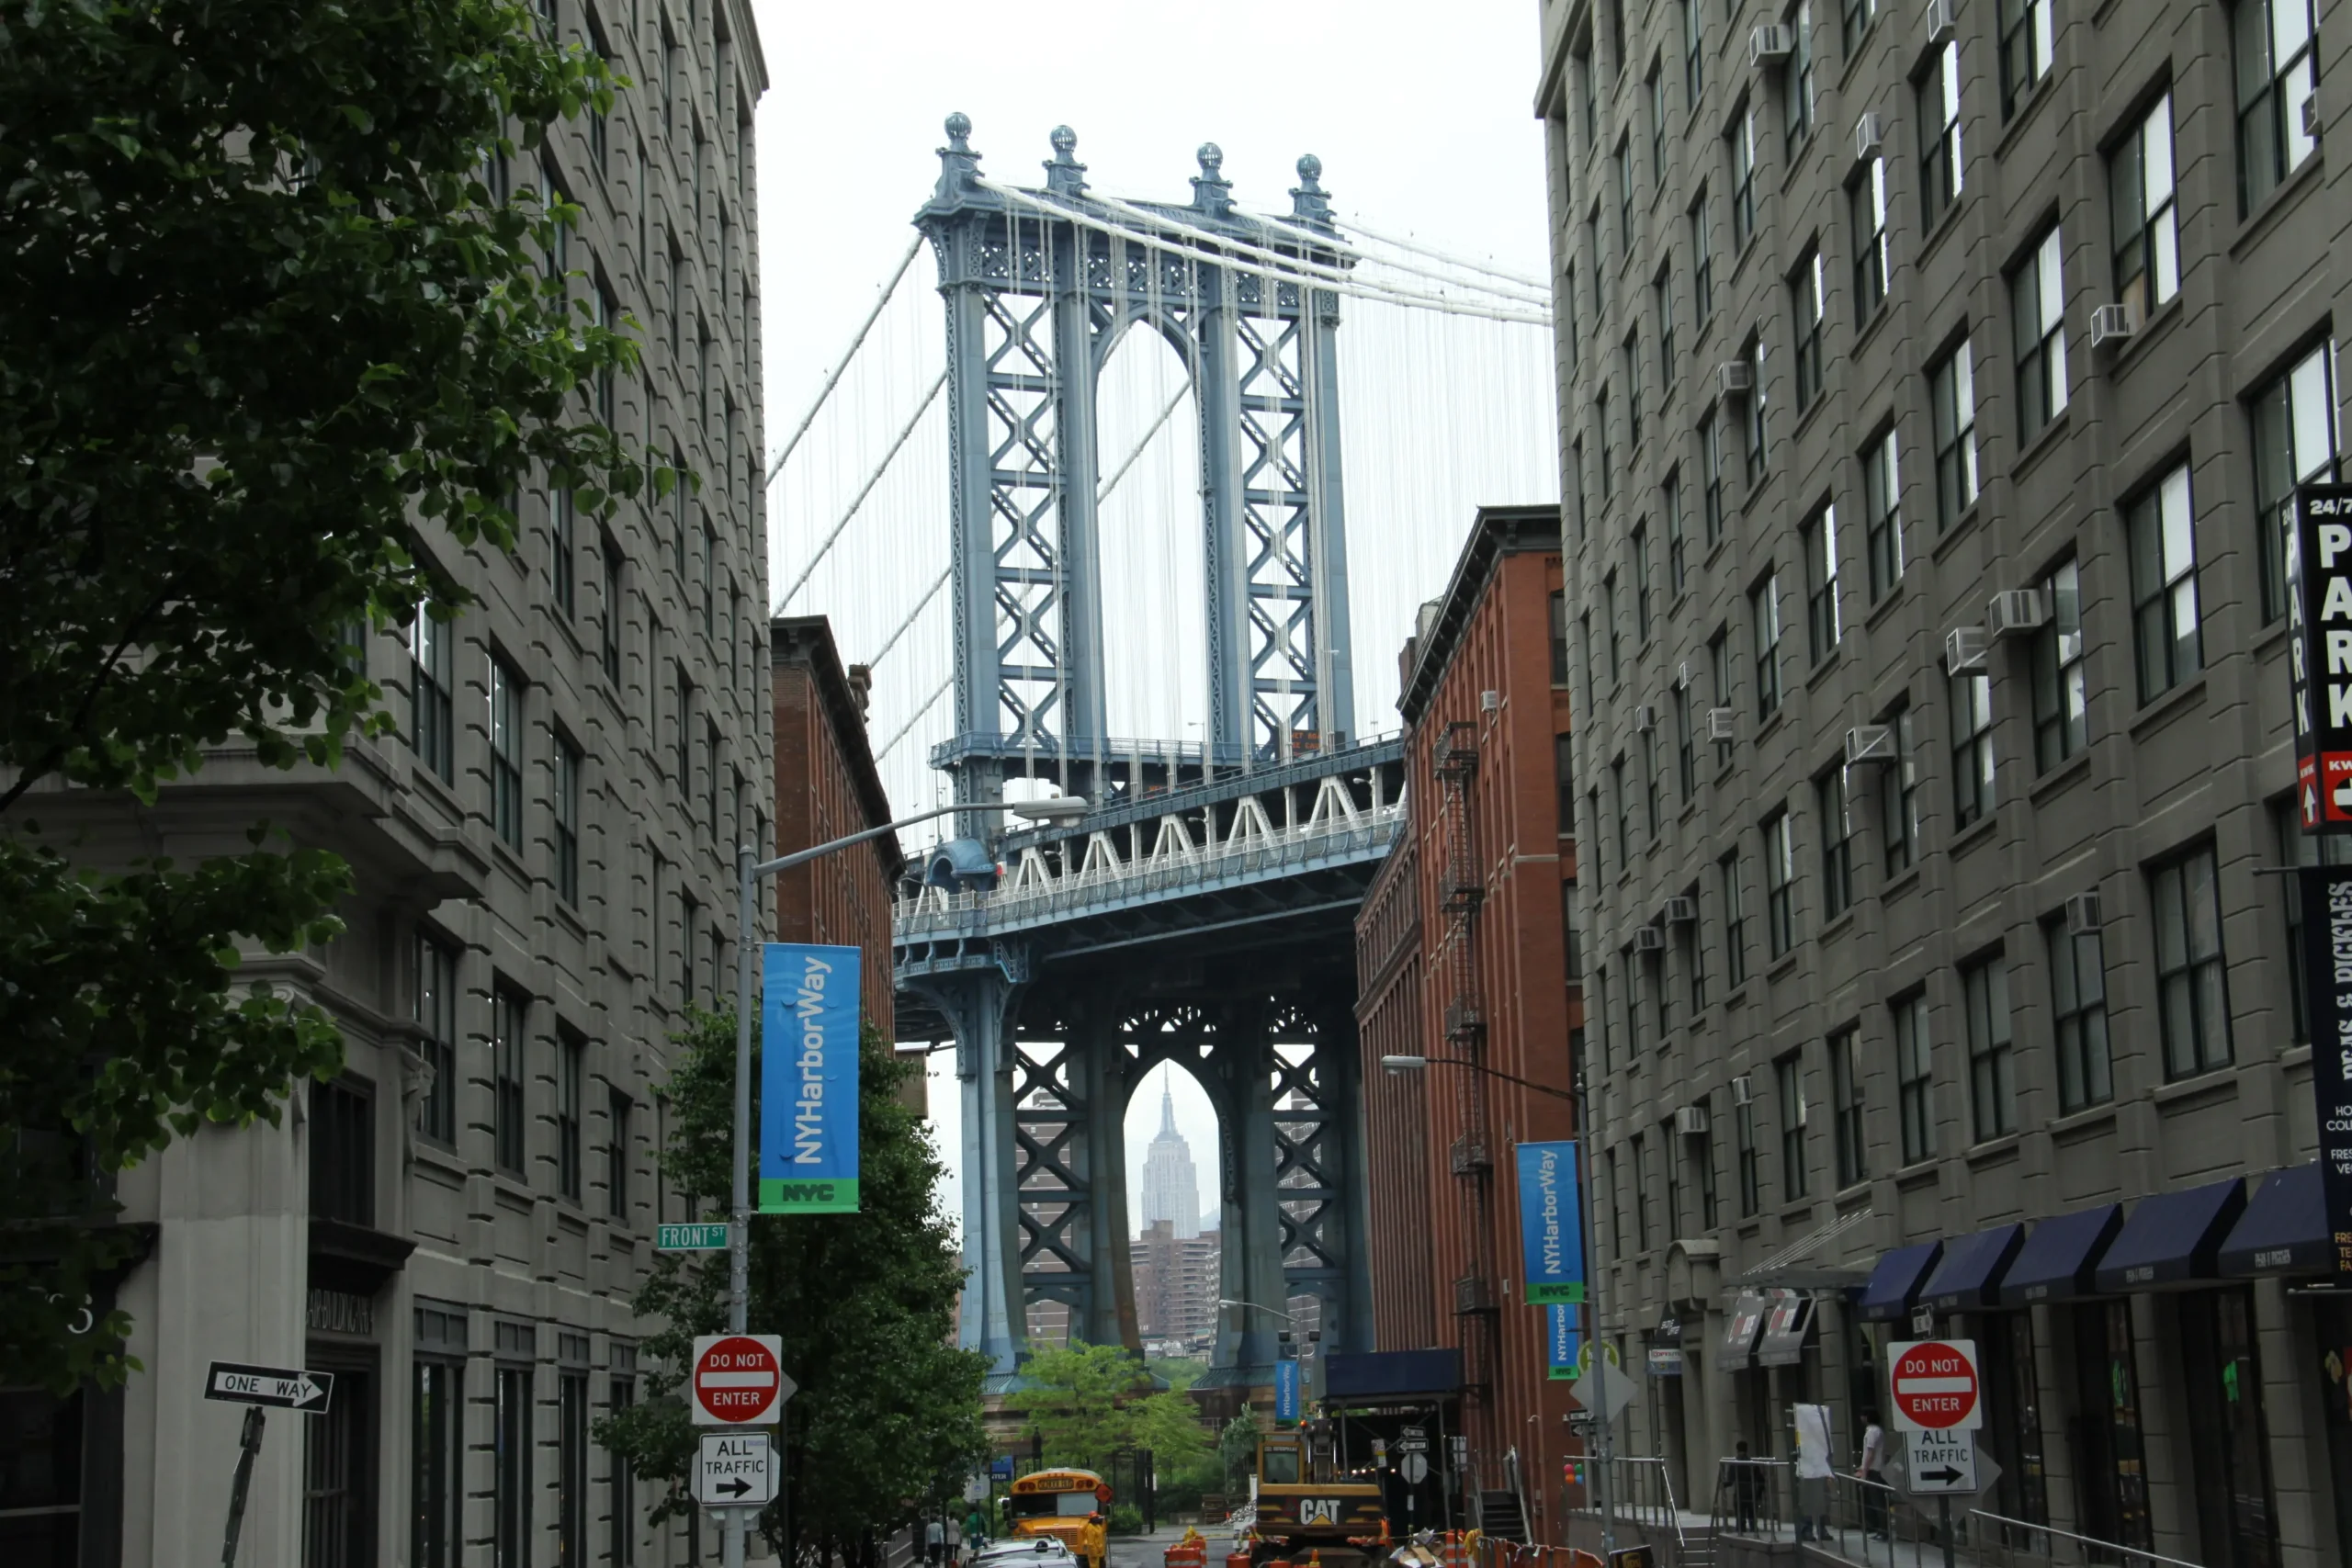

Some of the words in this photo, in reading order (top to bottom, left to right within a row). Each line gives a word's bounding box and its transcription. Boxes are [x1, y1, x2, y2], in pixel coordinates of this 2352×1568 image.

[2309, 497, 2352, 516] 24/7
[794, 956, 832, 1164] NYHarborWay
[2325, 1120, 2352, 1132] COL
[782, 1184, 835, 1202] NYC
[1538, 1150, 1562, 1275] NYHarborWay
[662, 1226, 709, 1247] FRONT
[711, 1226, 725, 1237] ST
[1538, 1284, 1570, 1298] NYC
[1556, 1303, 1567, 1361] NYHarbor
[710, 1354, 730, 1368] DO
[736, 1353, 764, 1367] NOT
[1905, 1359, 1926, 1373] DO
[1931, 1359, 1960, 1372] NOT
[225, 1375, 260, 1393] ONE
[277, 1381, 312, 1398] WAY
[713, 1392, 760, 1405] ENTER
[1912, 1398, 1960, 1412] ENTER
[1921, 1430, 1958, 1445] ALL
[717, 1440, 753, 1456] ALL
[1914, 1448, 1969, 1463] TRAFFIC
[706, 1460, 764, 1474] TRAFFIC
[1300, 1498, 1340, 1525] CAT
